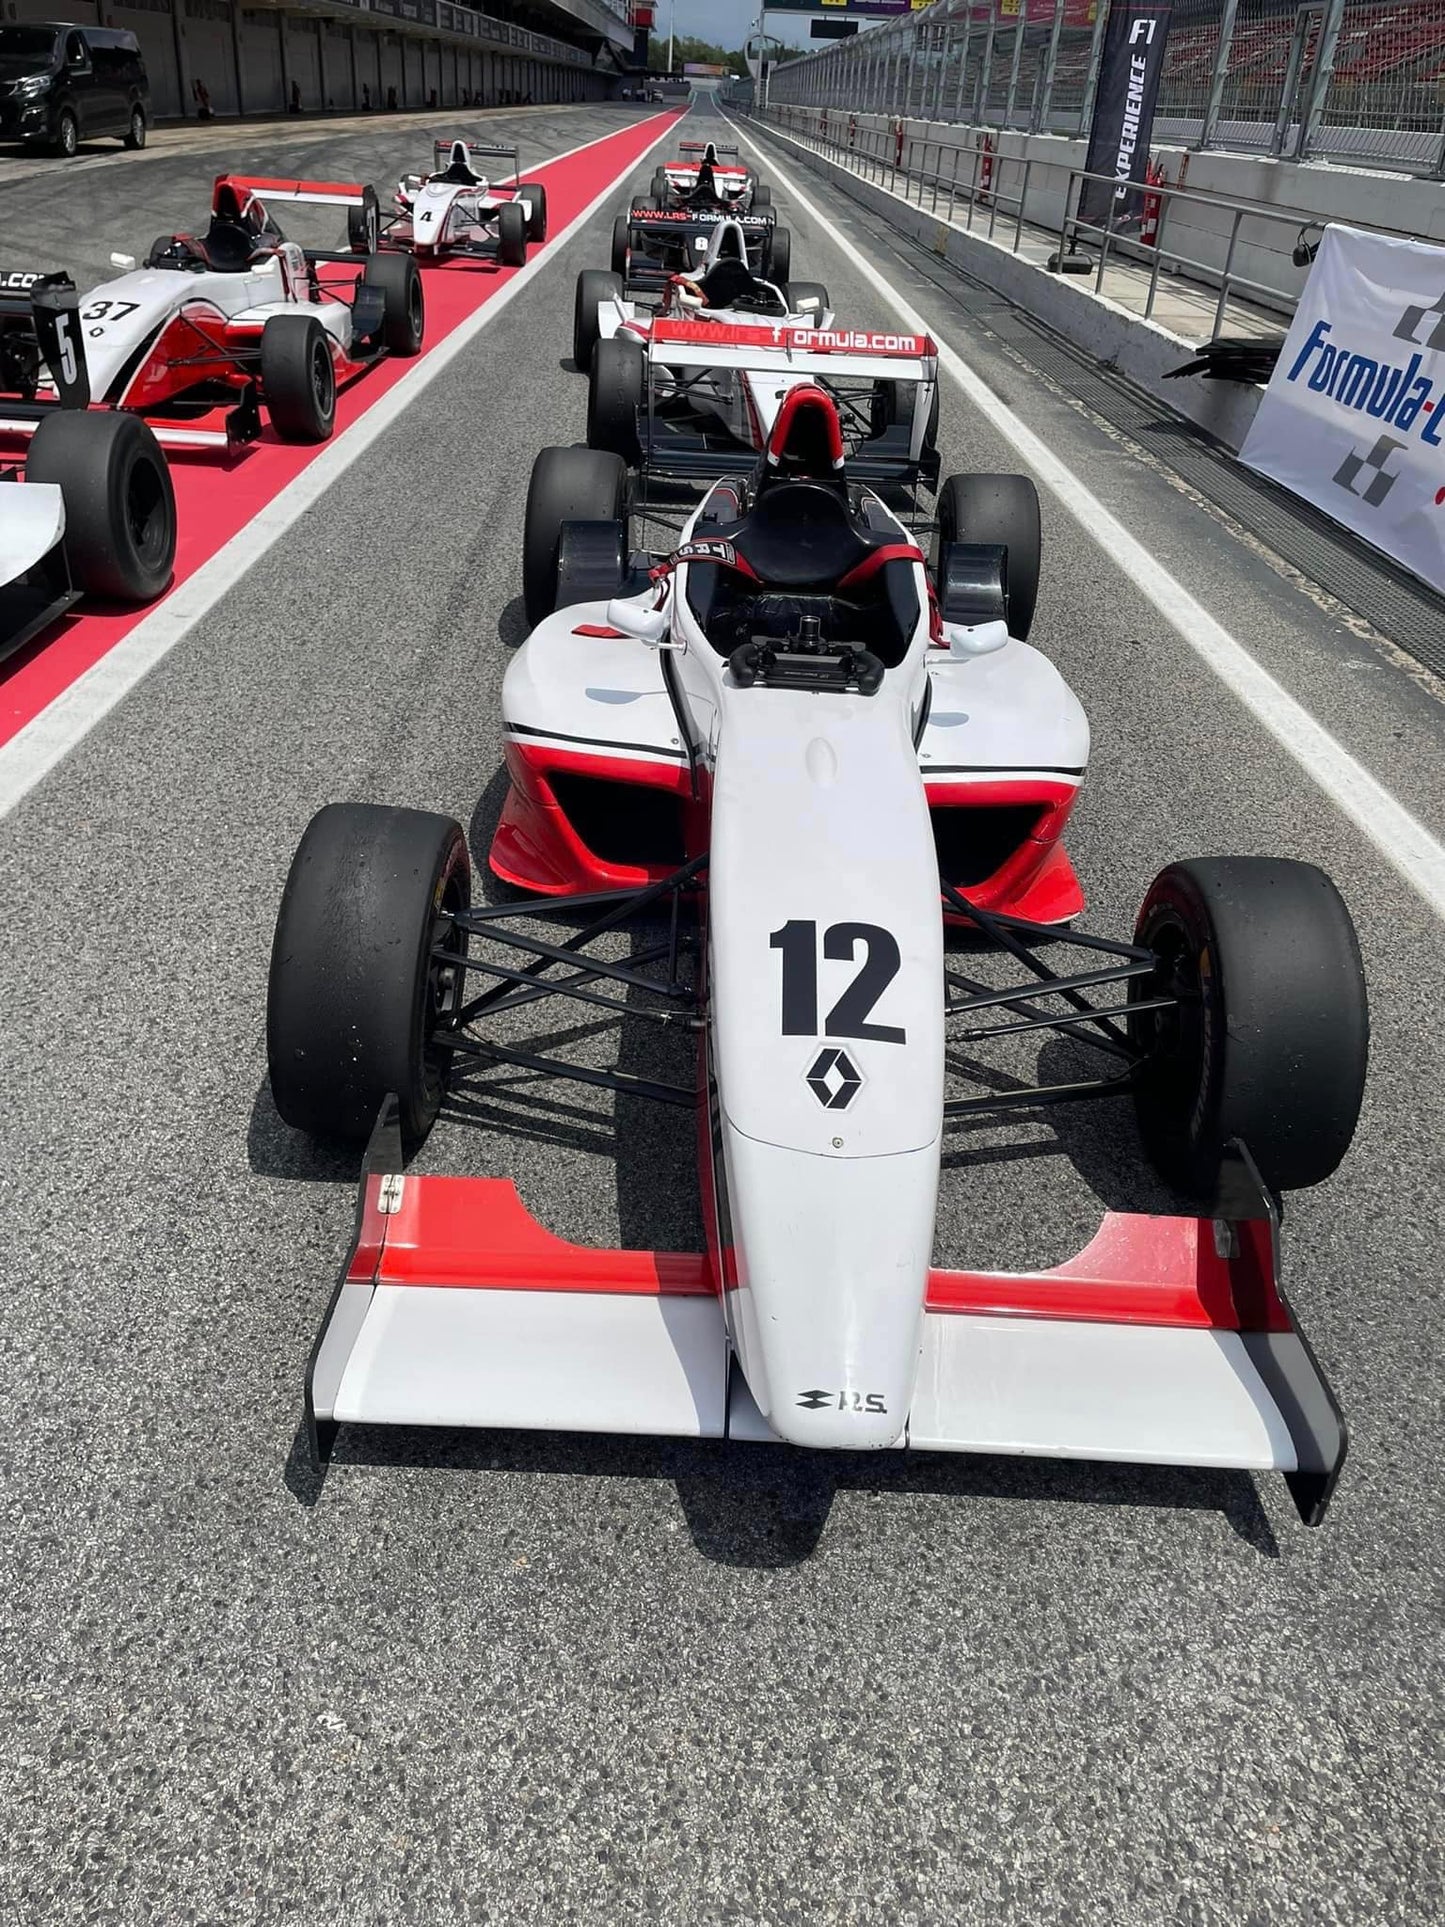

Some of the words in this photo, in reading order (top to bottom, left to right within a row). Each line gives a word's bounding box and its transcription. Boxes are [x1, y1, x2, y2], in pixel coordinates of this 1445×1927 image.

[1128, 18, 1157, 45] F1
[1113, 53, 1147, 200] EXPERIENCE
[420, 210, 432, 222] 4
[82, 301, 141, 321] 37
[55, 313, 78, 385] 5
[768, 919, 907, 1045] 12
